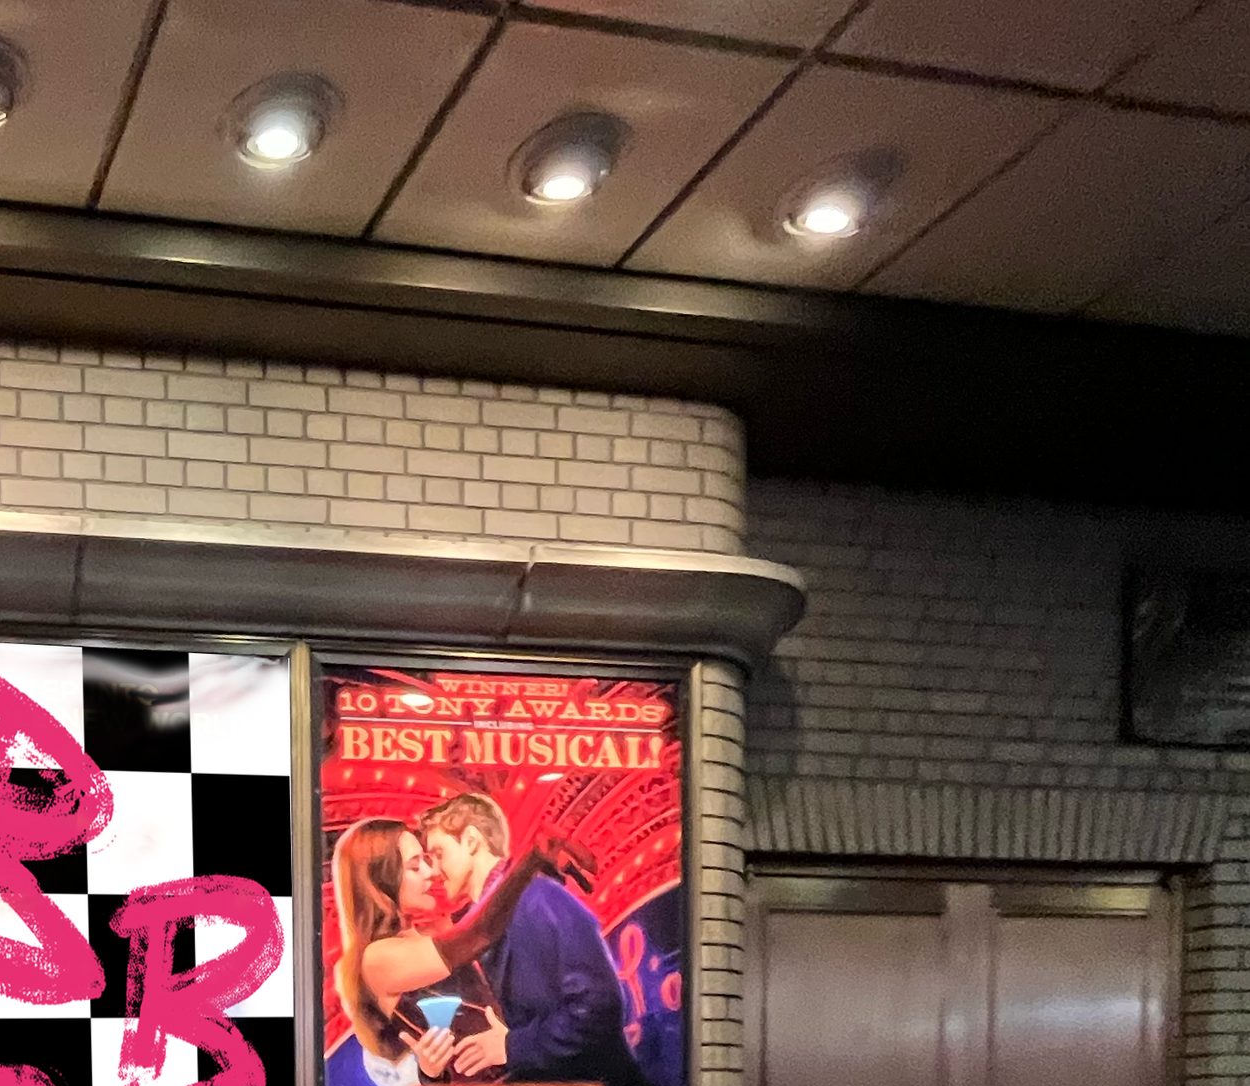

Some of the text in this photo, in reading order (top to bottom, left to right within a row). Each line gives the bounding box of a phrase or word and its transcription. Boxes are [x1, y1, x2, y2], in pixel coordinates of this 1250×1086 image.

[339, 692, 666, 723] 10 TONY AWARDS
[340, 726, 664, 769] BEST MUSICAL!
